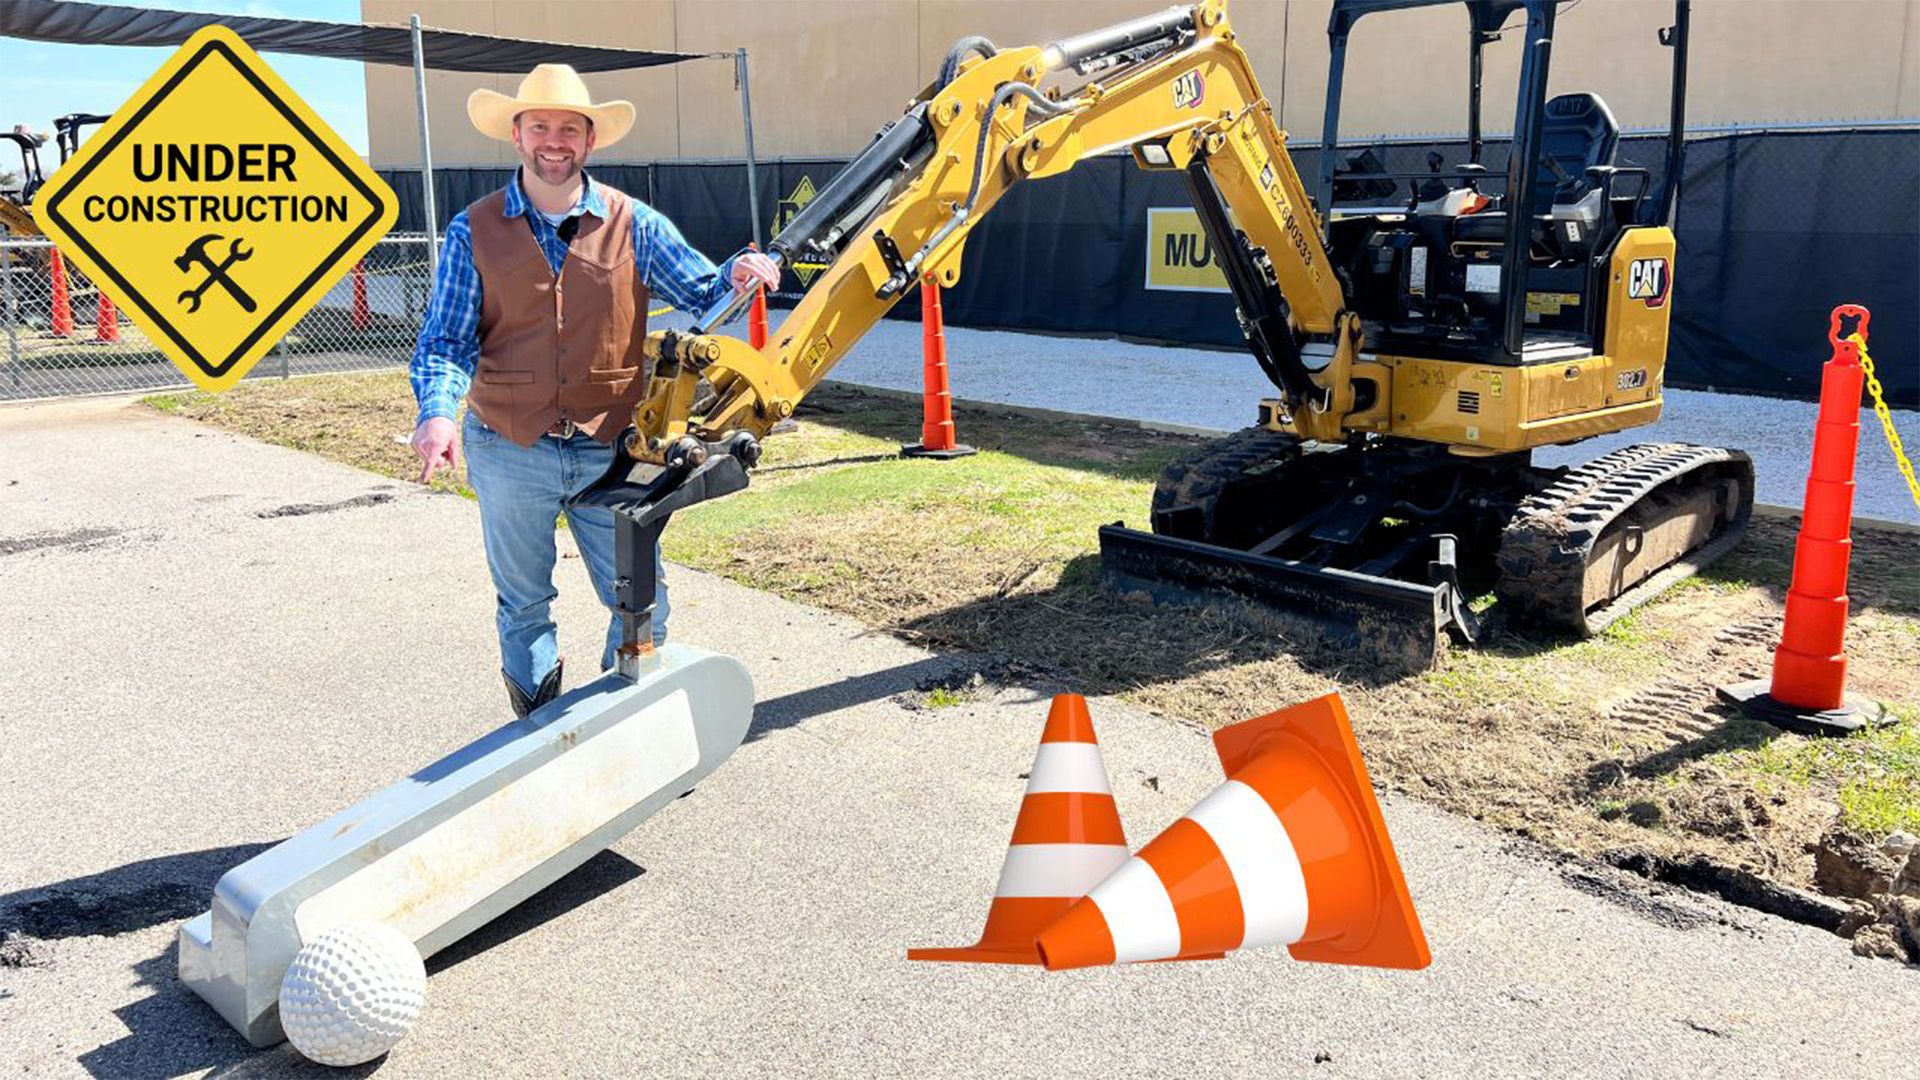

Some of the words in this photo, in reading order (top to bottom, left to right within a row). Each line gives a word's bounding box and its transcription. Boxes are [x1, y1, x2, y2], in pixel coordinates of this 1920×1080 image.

[1173, 68, 1200, 108] CAT
[1165, 233, 1221, 268] MU
[1629, 259, 1664, 298] CAT
[1616, 370, 1645, 390] 302.7
